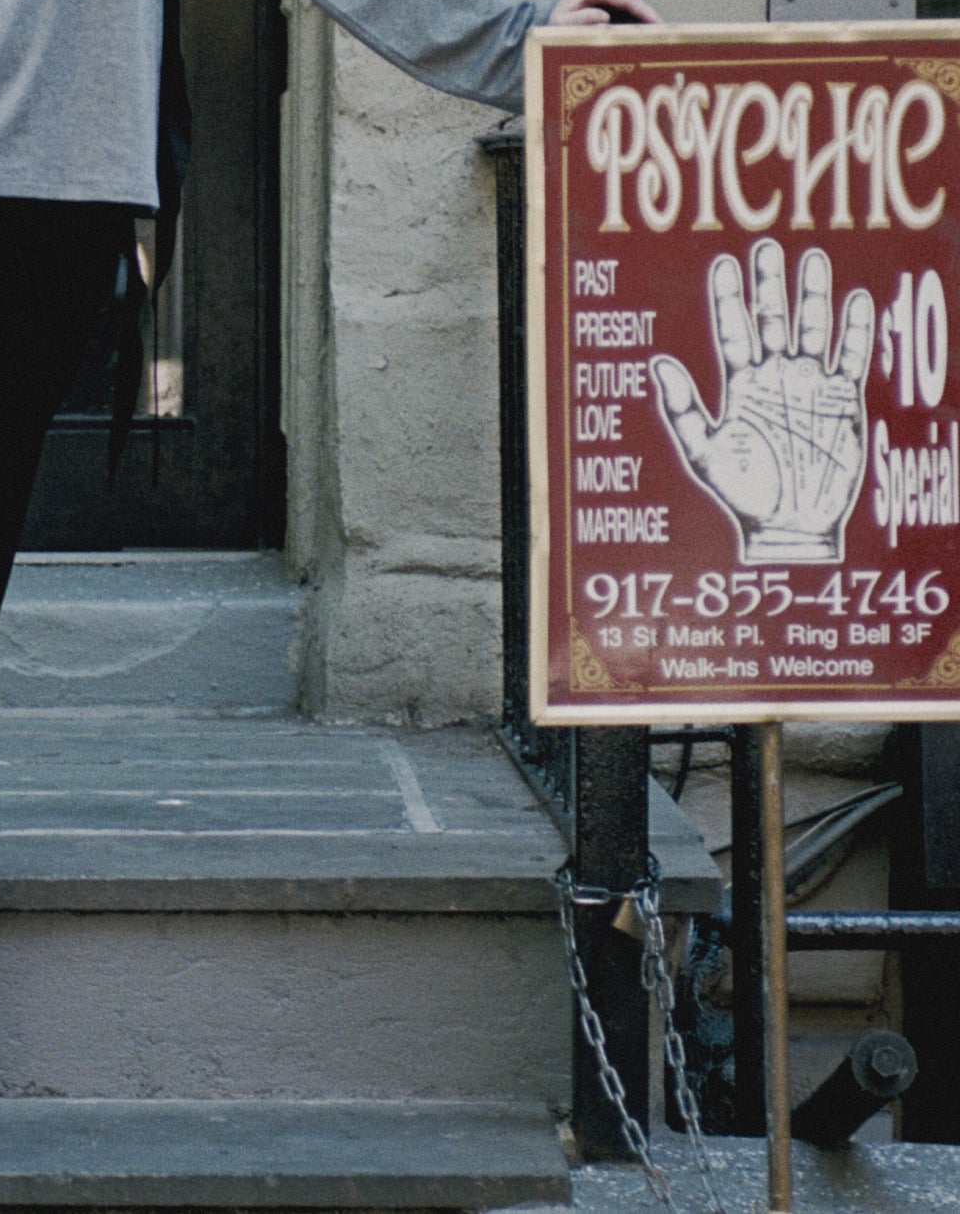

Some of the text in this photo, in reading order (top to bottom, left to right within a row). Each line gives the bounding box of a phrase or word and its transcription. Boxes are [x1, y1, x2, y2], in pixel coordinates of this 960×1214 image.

[587, 78, 947, 233] PSYCHIC
[575, 260, 619, 296] PAST
[575, 311, 657, 347] PRESENT
[880, 269, 948, 407] $10
[576, 362, 648, 398] FUTURE
[576, 404, 622, 441] LOVE
[576, 456, 643, 492] MONEY
[873, 418, 960, 548] Special
[577, 506, 670, 543] MARRIAGE
[584, 570, 950, 619] 917-855-4746
[599, 623, 932, 649] 13 St Mark Pl. Ring Bell 3F
[661, 655, 874, 678] Walk-Ins Welcome
